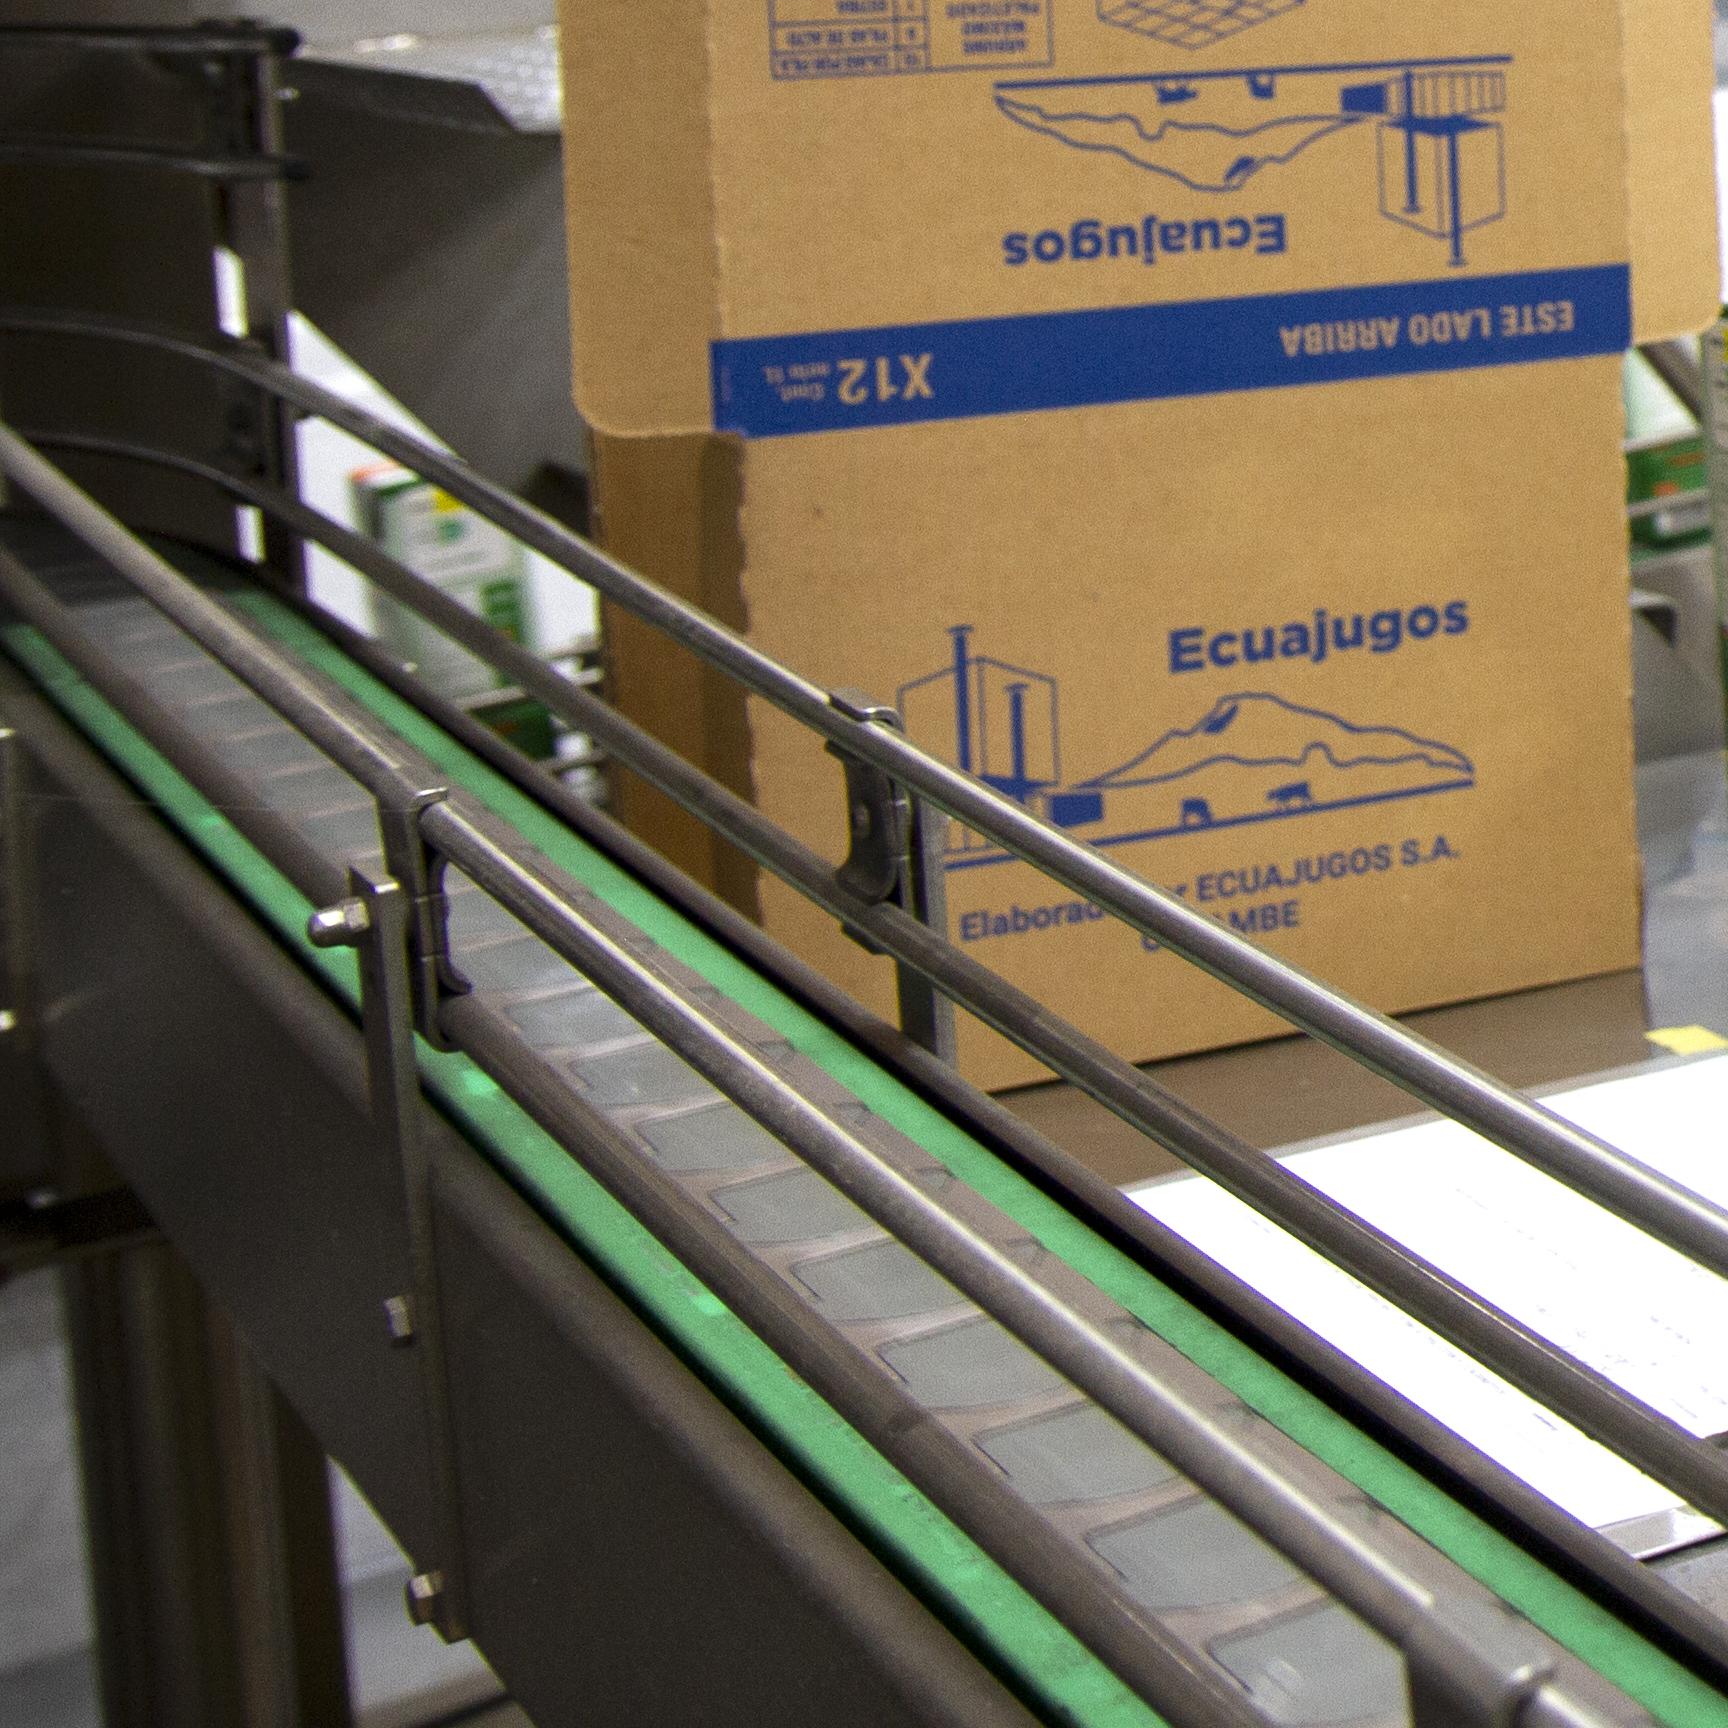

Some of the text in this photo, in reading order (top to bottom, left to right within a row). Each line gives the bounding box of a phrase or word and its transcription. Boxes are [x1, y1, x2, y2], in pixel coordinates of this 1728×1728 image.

[1002, 214, 1287, 267] Ecuajugos
[1279, 299, 1575, 357] ESTE LADO ARRIBA
[837, 353, 933, 405] X12
[1167, 599, 1470, 673] Ecuajugos
[1195, 844, 1391, 902] ECUAJUGOS
[1401, 835, 1461, 867] S.A.
